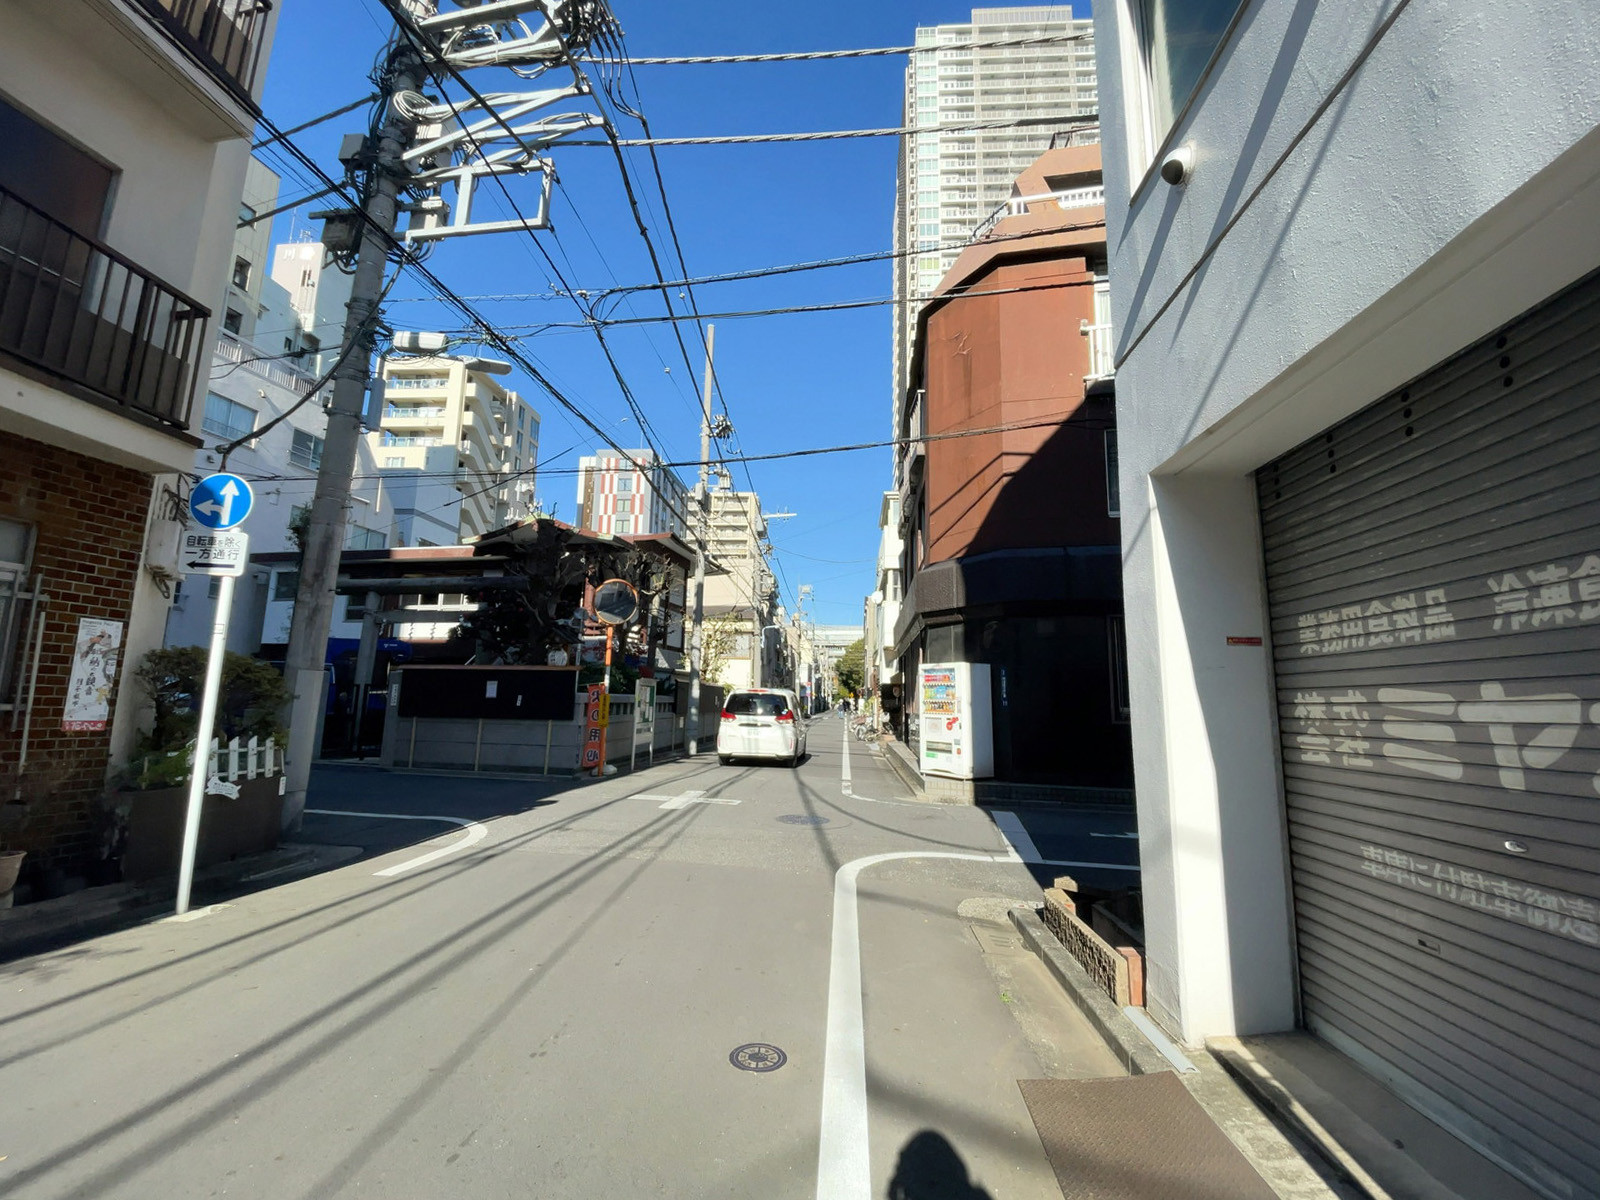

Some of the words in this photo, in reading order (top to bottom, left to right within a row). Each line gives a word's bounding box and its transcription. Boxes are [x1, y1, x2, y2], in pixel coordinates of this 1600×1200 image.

[185, 548, 239, 560] 一方通行
[187, 535, 241, 547] 自転車を除く
[1298, 589, 1456, 655] 業務用食料品
[1294, 691, 1369, 726] 株式
[1296, 732, 1374, 767] 会社
[1377, 681, 1600, 794] ミヤ
